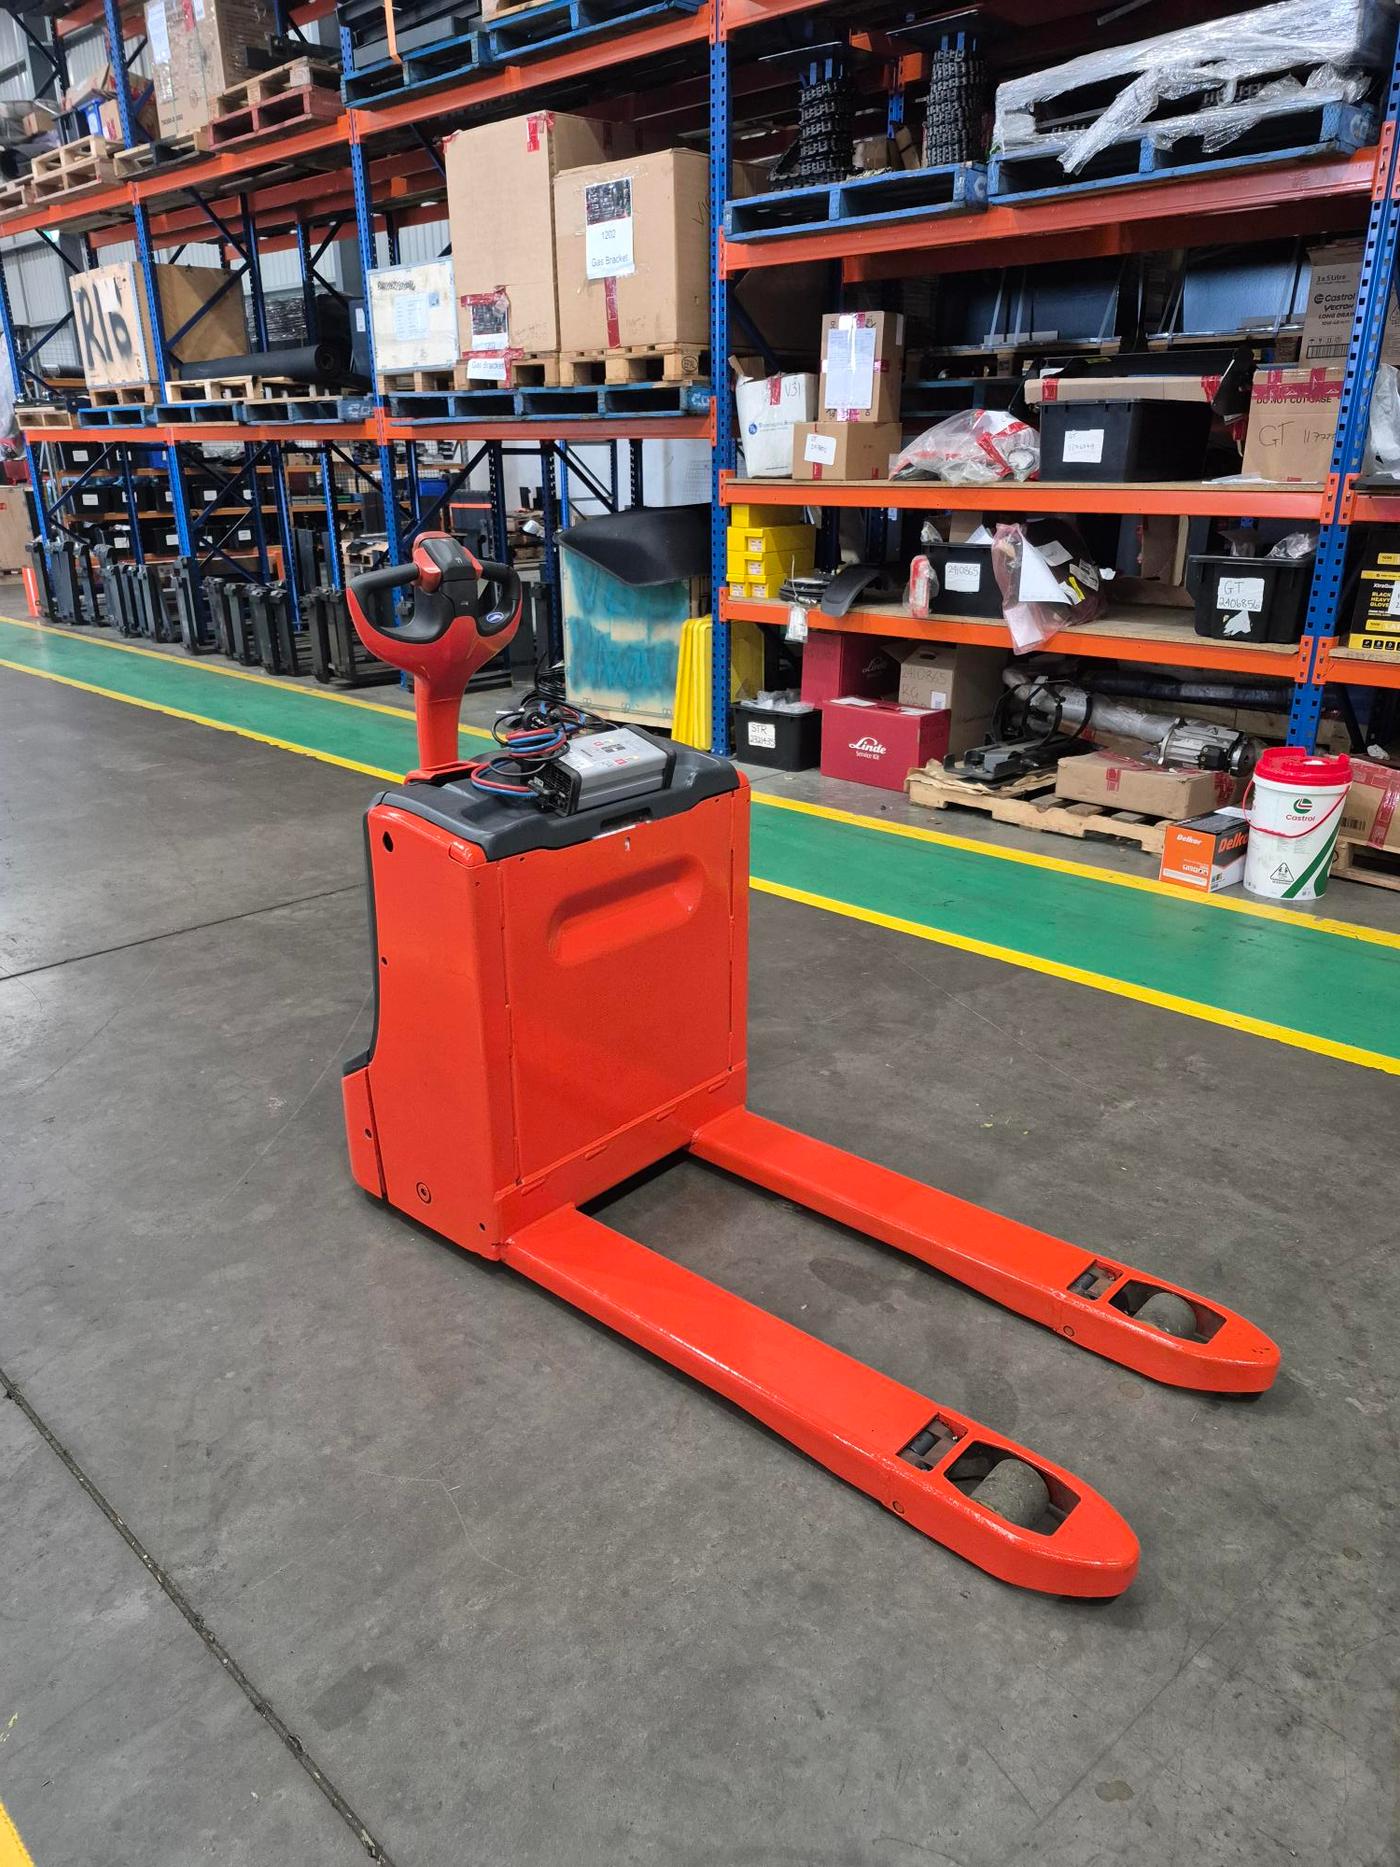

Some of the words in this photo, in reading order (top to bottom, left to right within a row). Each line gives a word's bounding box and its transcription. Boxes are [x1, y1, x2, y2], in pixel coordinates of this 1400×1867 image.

[591, 258, 604, 267] Gas
[605, 255, 628, 265] Bracket
[1325, 293, 1356, 302] Castrol
[1259, 421, 1295, 447] GT
[1224, 581, 1244, 595] GT
[751, 723, 768, 735] STR
[849, 736, 886, 754] Linde
[1285, 814, 1316, 822] Castrol
[1176, 834, 1202, 845] Delkor
